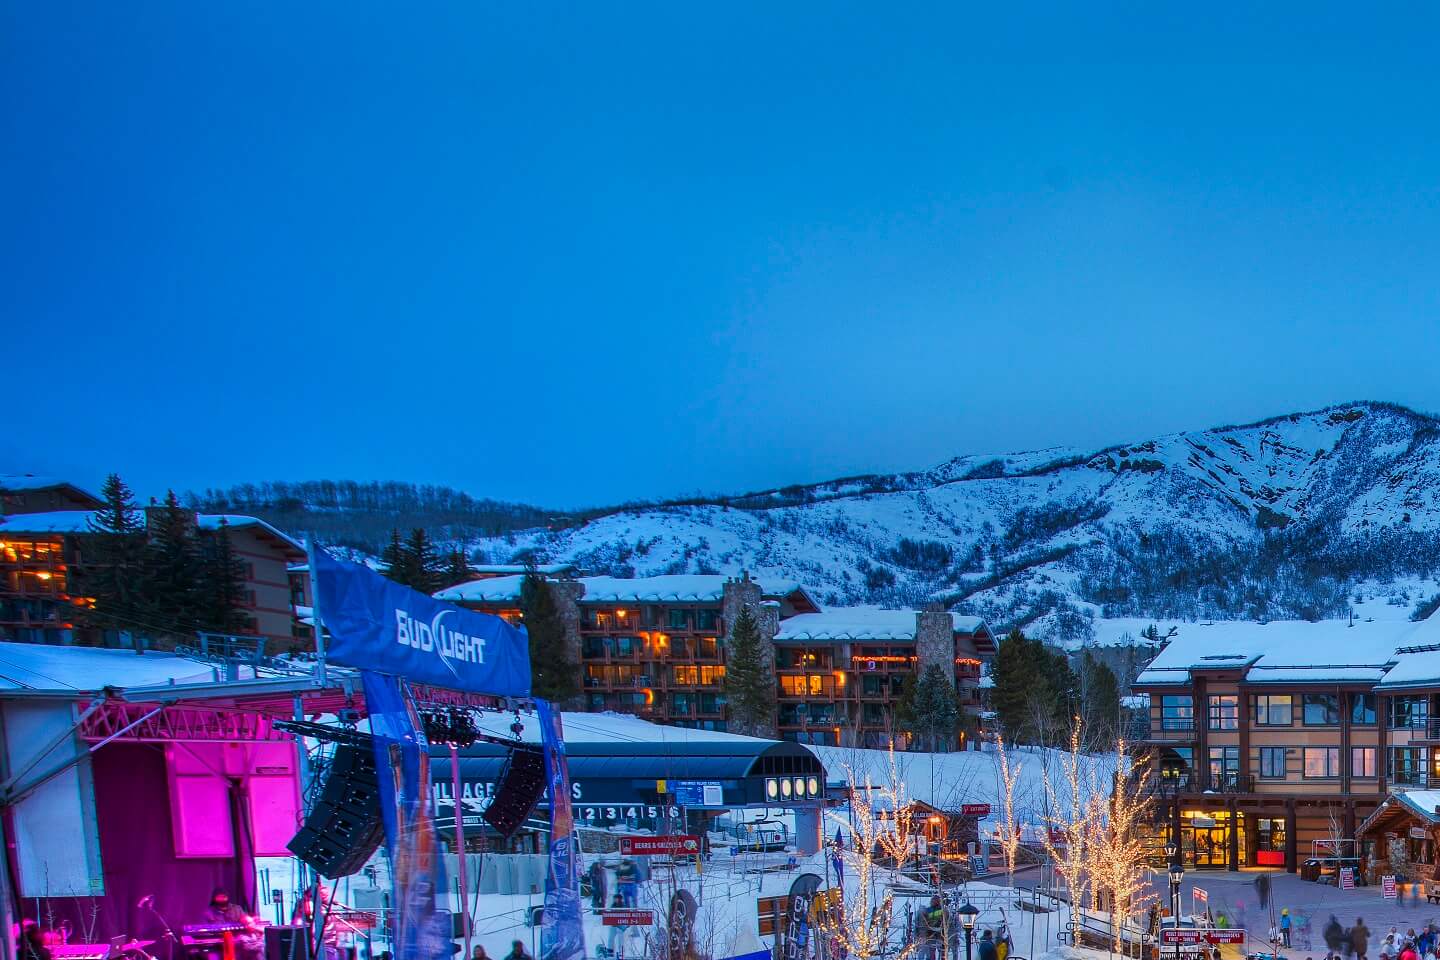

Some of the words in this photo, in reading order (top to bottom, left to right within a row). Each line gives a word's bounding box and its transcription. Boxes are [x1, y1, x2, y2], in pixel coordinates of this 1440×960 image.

[395, 608, 434, 652] BUD
[439, 624, 486, 664] LIGHT
[585, 807, 596, 819] 2
[606, 807, 617, 819] 3
[626, 807, 637, 819] 4
[648, 806, 658, 818] 5
